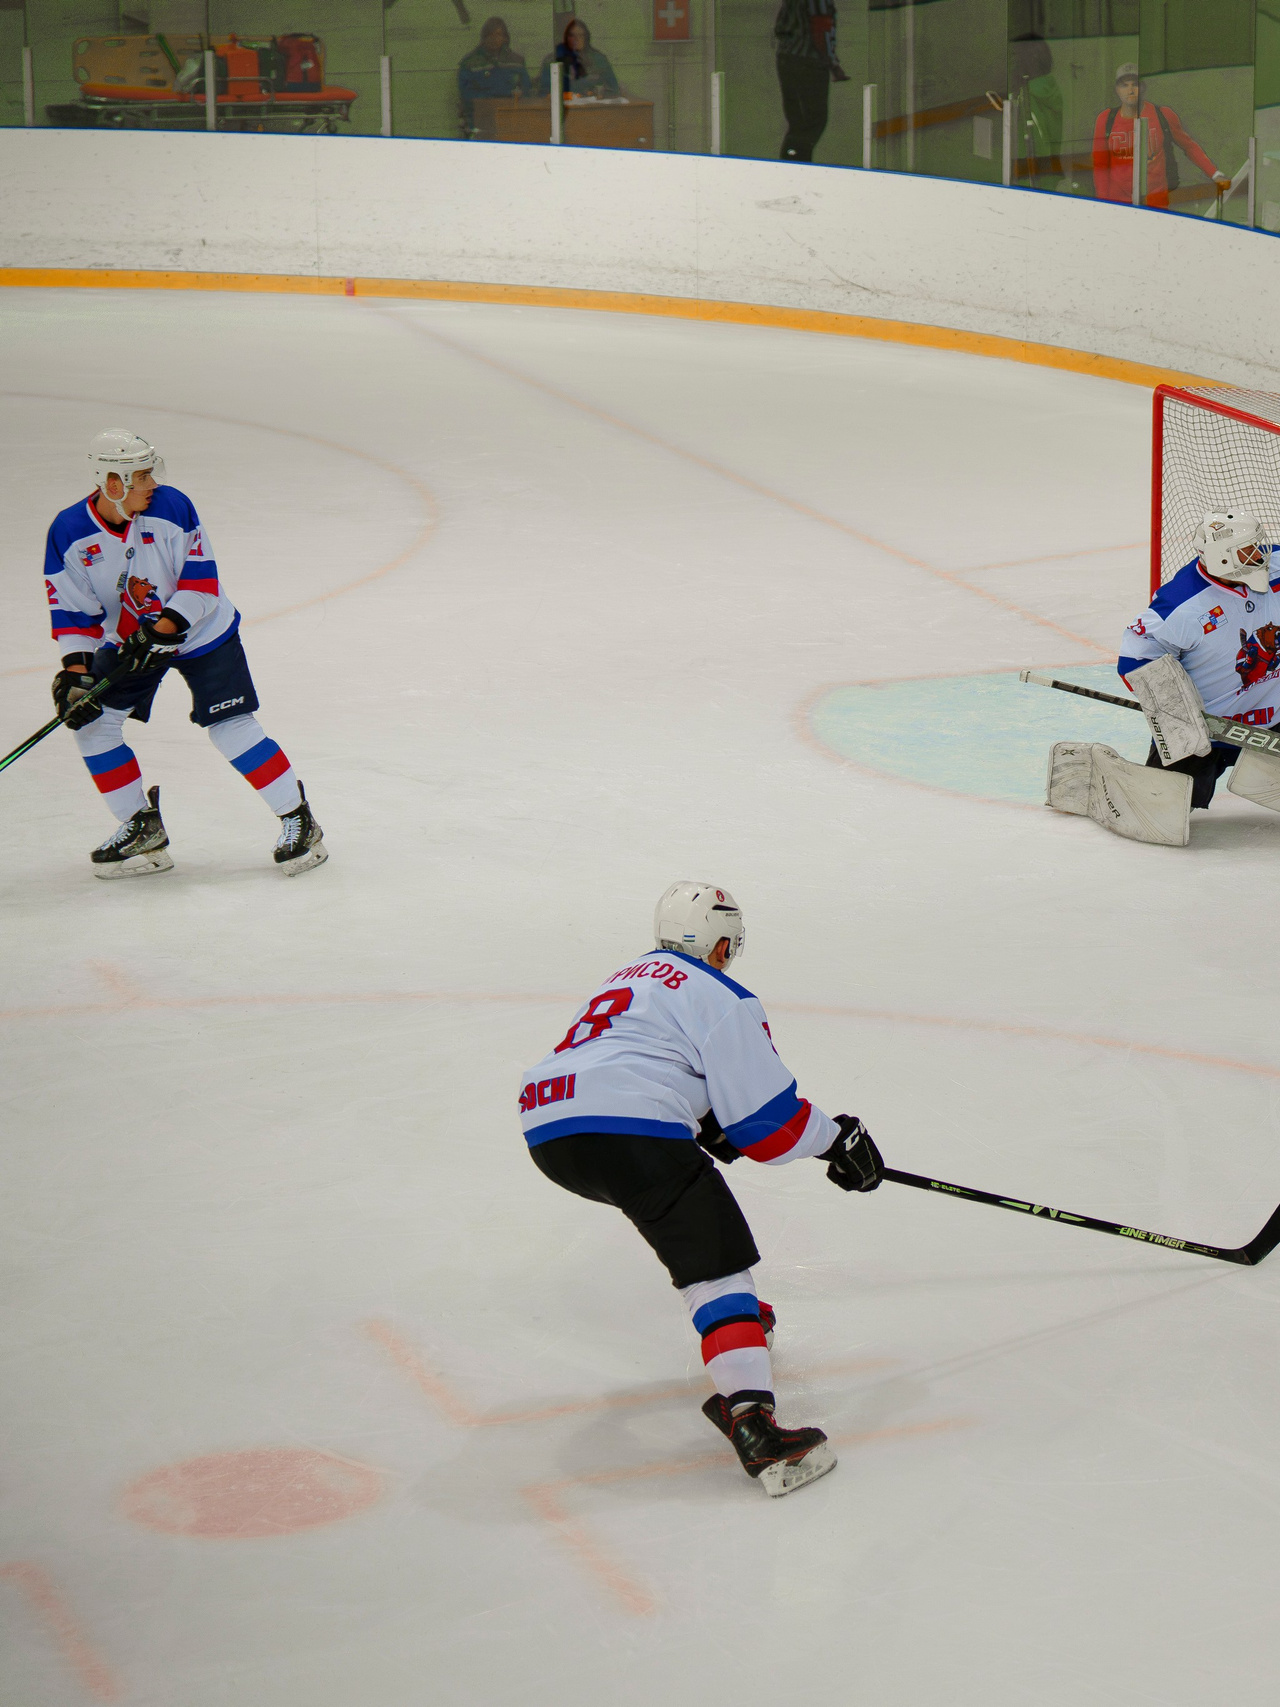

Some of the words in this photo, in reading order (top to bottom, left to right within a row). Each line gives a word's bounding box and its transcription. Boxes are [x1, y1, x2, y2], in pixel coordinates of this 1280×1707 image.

[208, 695, 246, 714] CCM
[1150, 715, 1172, 761] BAUER
[553, 986, 635, 1056] 8
[1148, 1232, 1187, 1250] TIMER
